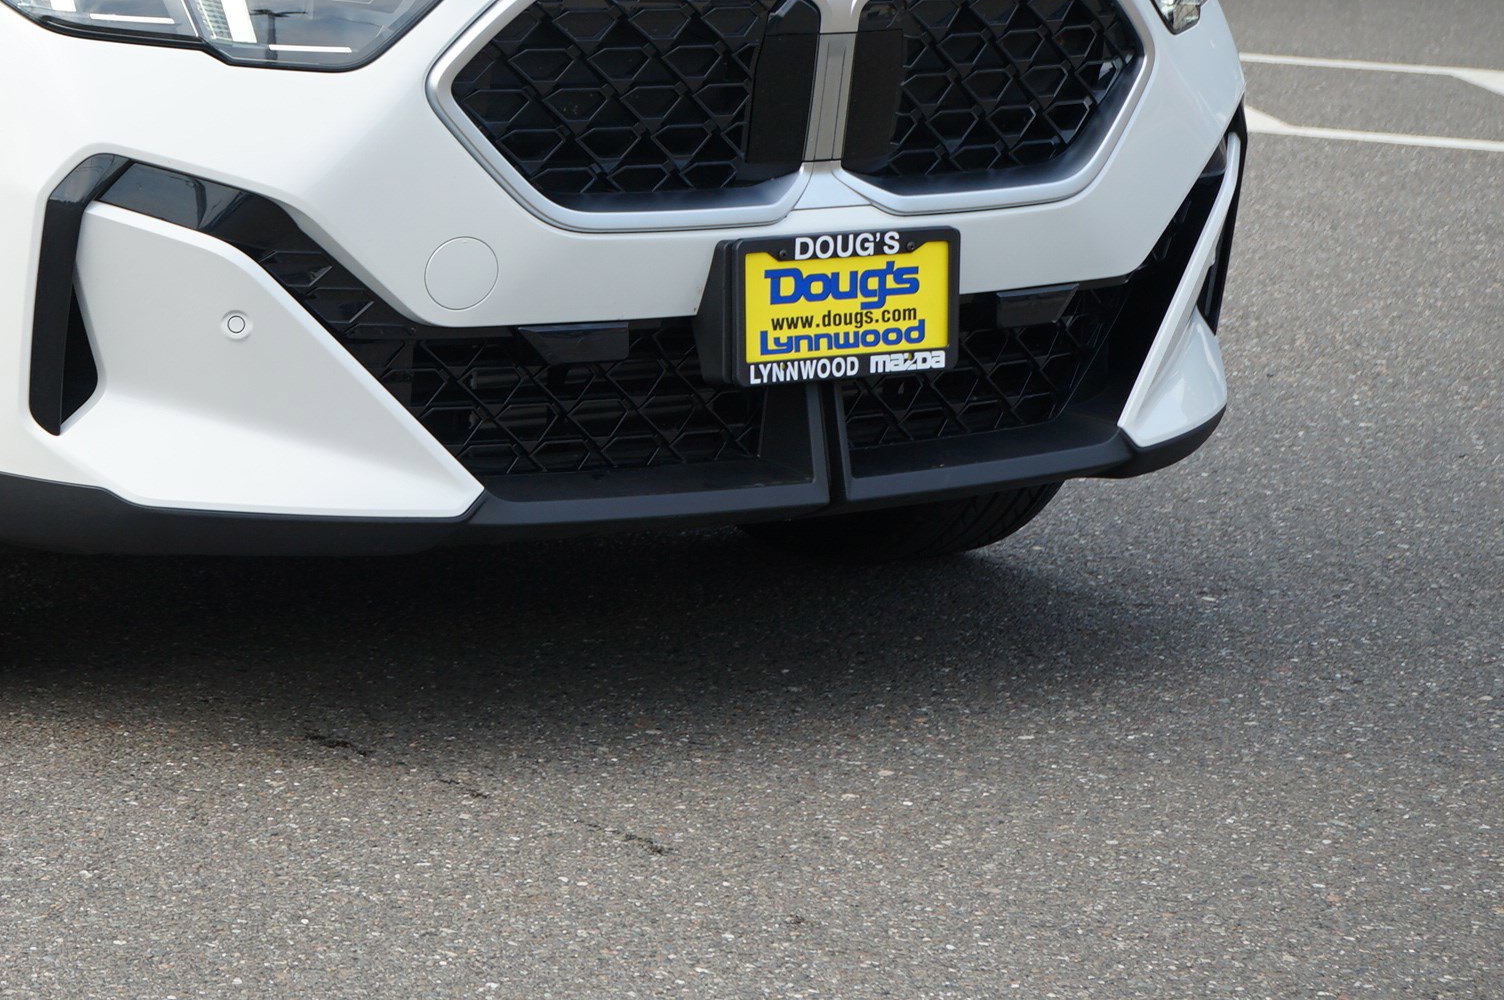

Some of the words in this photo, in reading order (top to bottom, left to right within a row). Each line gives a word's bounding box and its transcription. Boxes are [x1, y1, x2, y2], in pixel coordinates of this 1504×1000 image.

[794, 231, 900, 261] DOUG'S
[764, 260, 920, 310] Doug's
[771, 307, 917, 331] www.dougs.com
[760, 319, 925, 356] Lynnwood
[749, 356, 859, 385] LYNNWOOD
